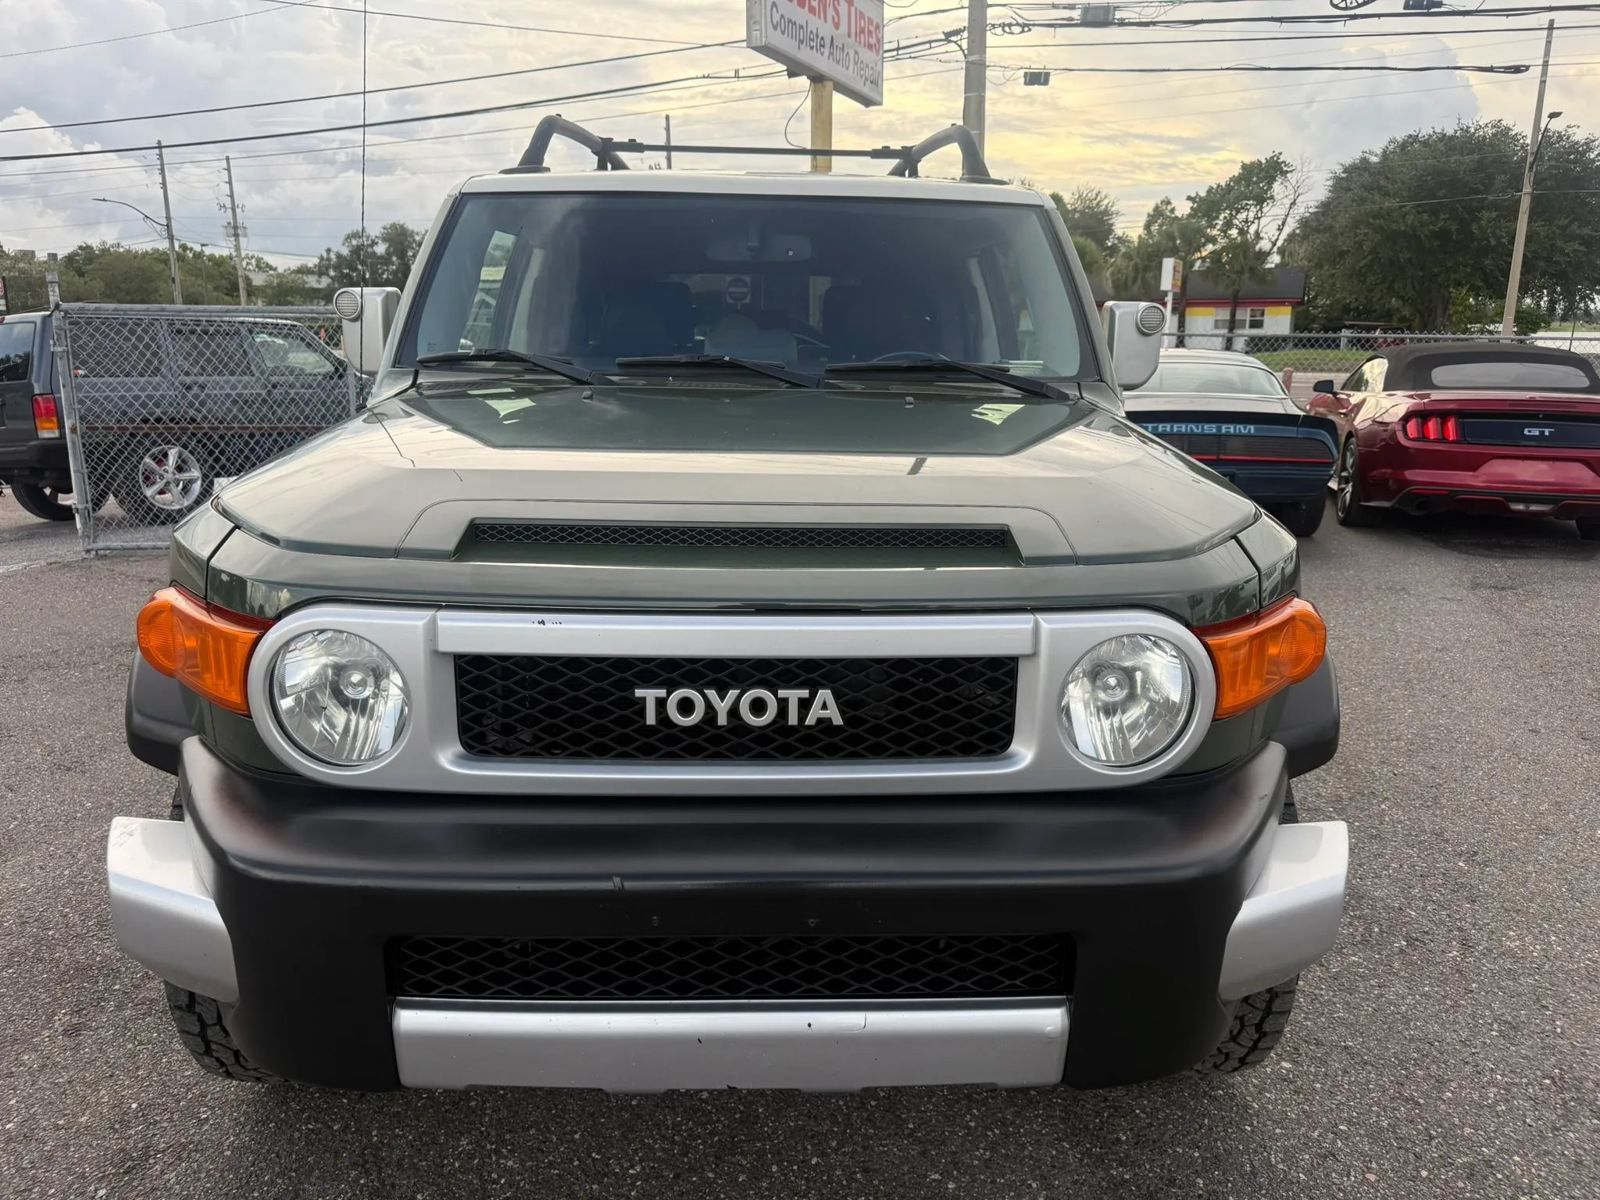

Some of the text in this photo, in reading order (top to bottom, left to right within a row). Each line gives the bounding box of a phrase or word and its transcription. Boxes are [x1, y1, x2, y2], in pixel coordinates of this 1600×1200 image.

[770, 1, 881, 87] Complete Auto Repair
[844, 0, 880, 57] TIRES
[1143, 423, 1255, 434] TRANS AM
[1523, 427, 1555, 436] GT
[634, 688, 844, 727] TOYOTA
